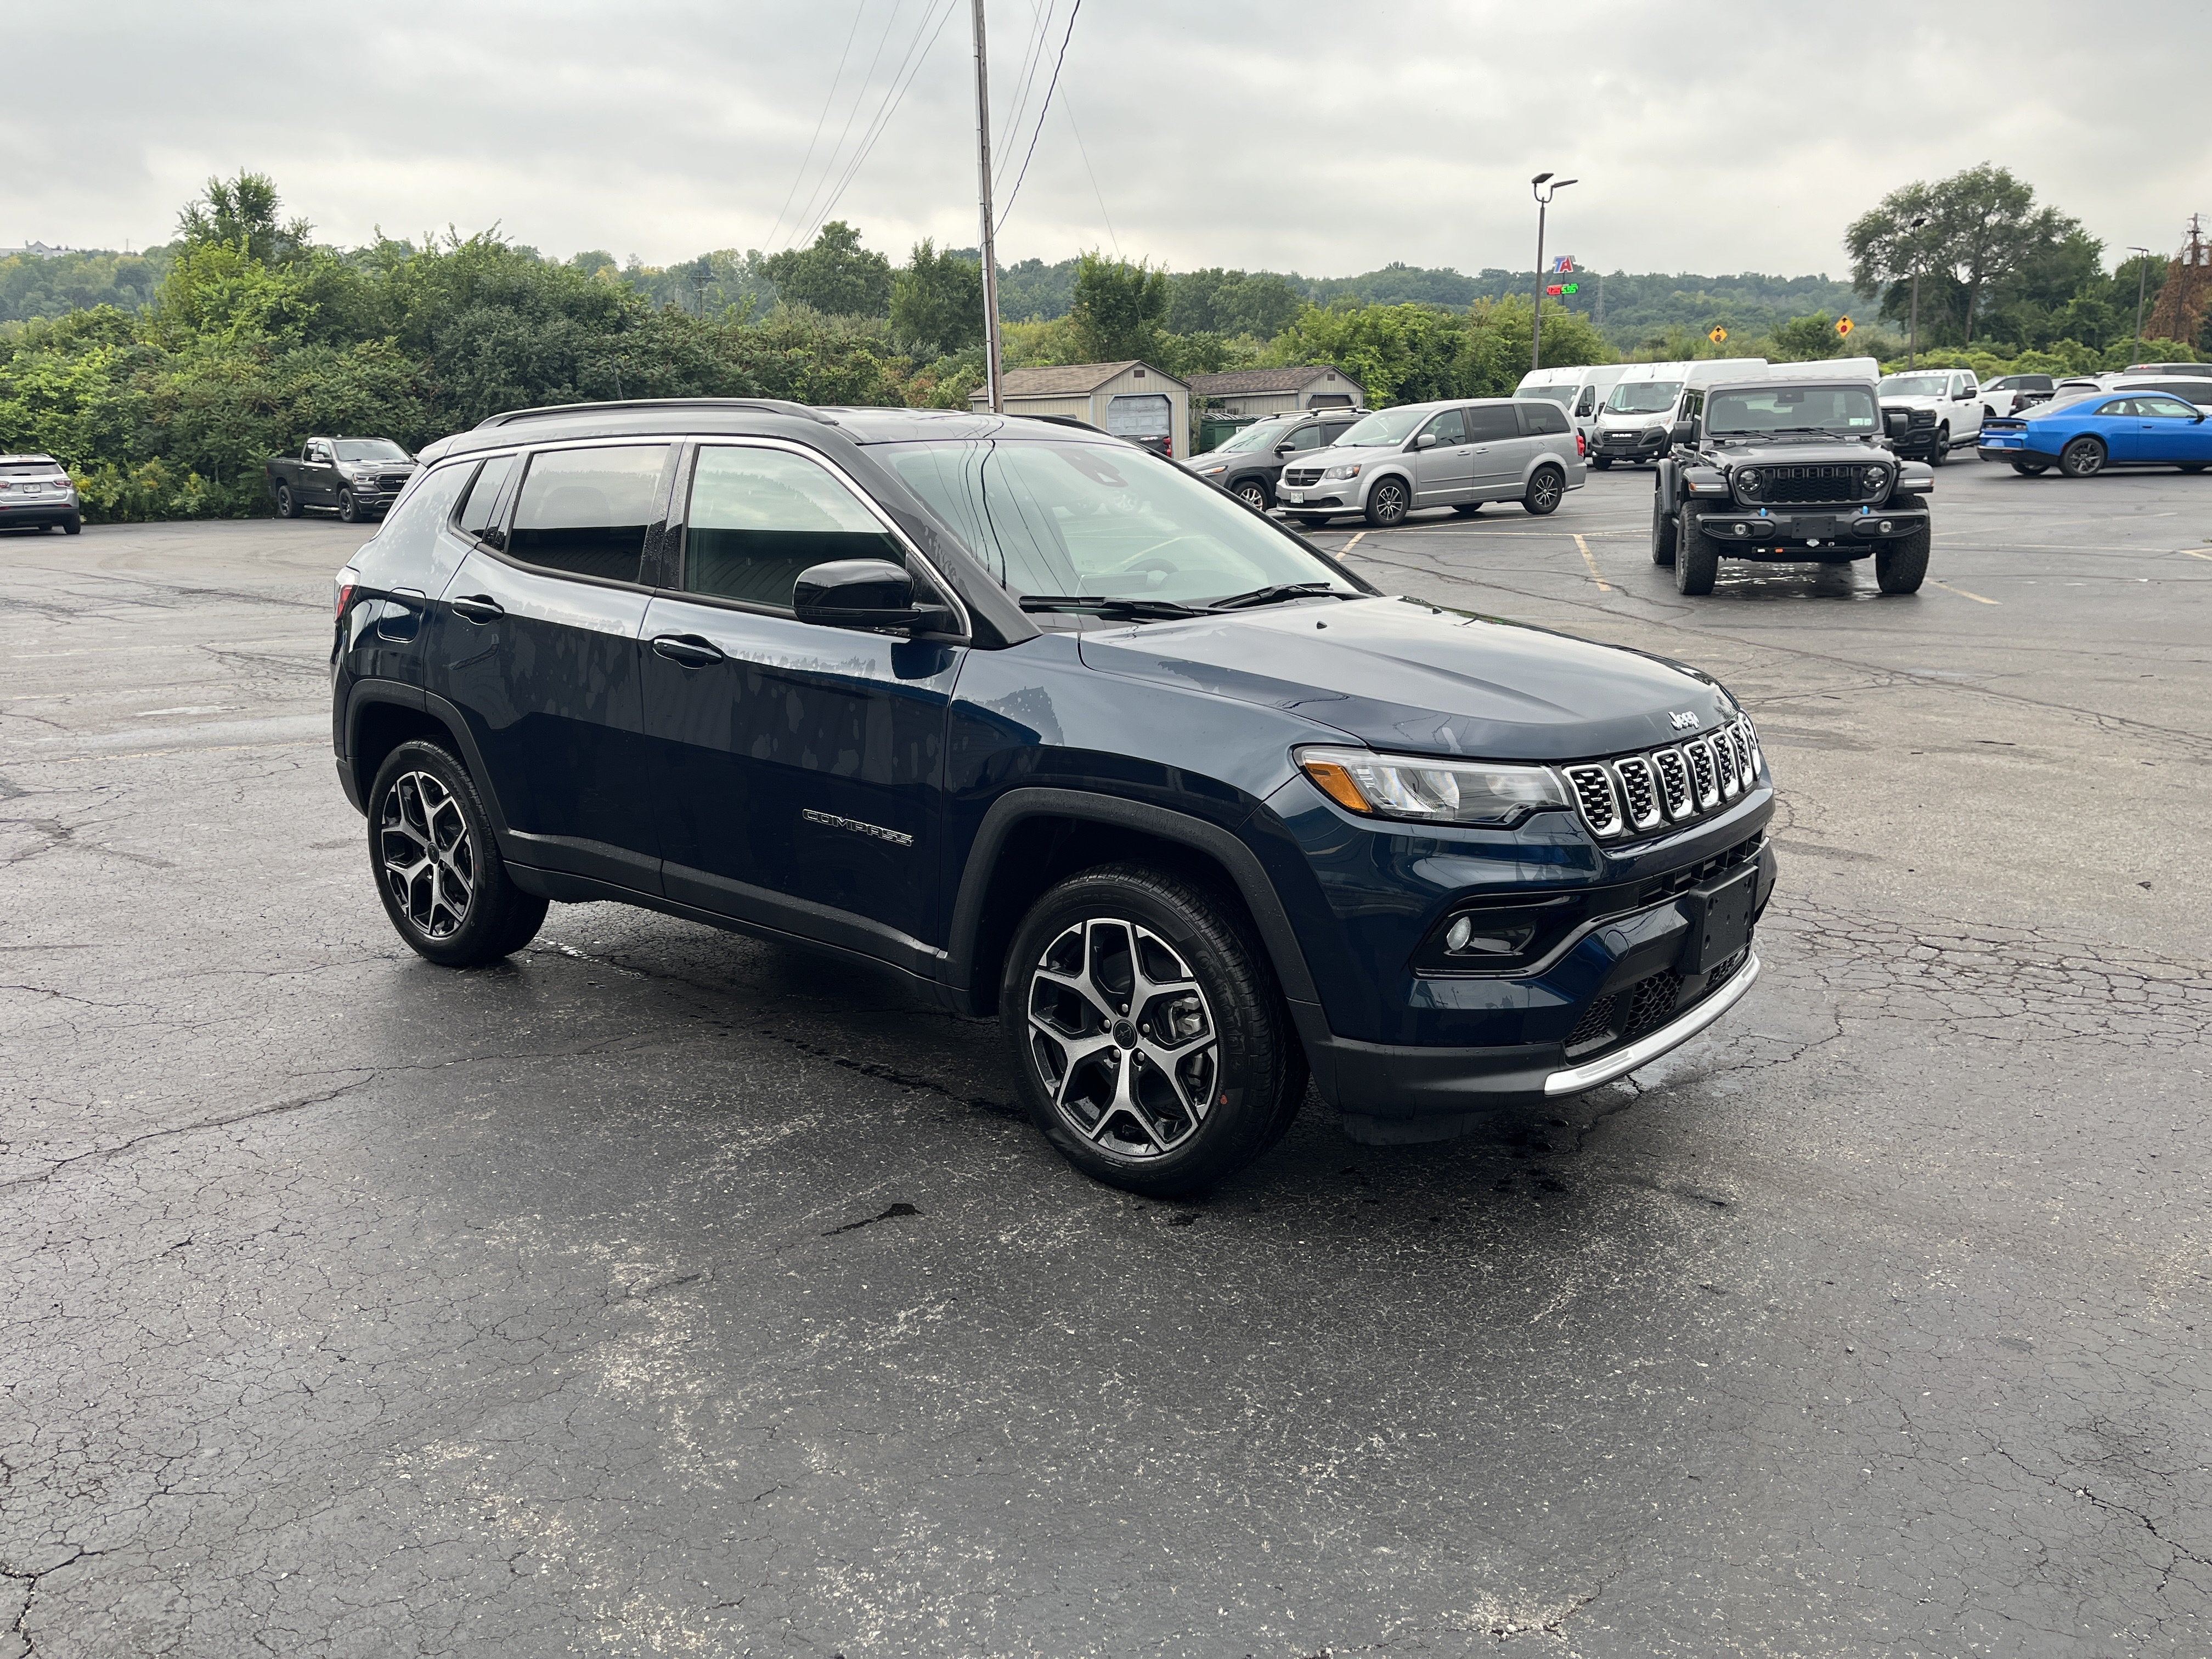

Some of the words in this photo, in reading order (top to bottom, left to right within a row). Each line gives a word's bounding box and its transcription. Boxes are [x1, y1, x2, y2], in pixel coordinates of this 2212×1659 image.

[1554, 256, 1572, 273] TA
[1668, 711, 1699, 730] Jeep
[802, 809, 913, 847] COMPASS
[1195, 950, 1245, 1054] Continental
